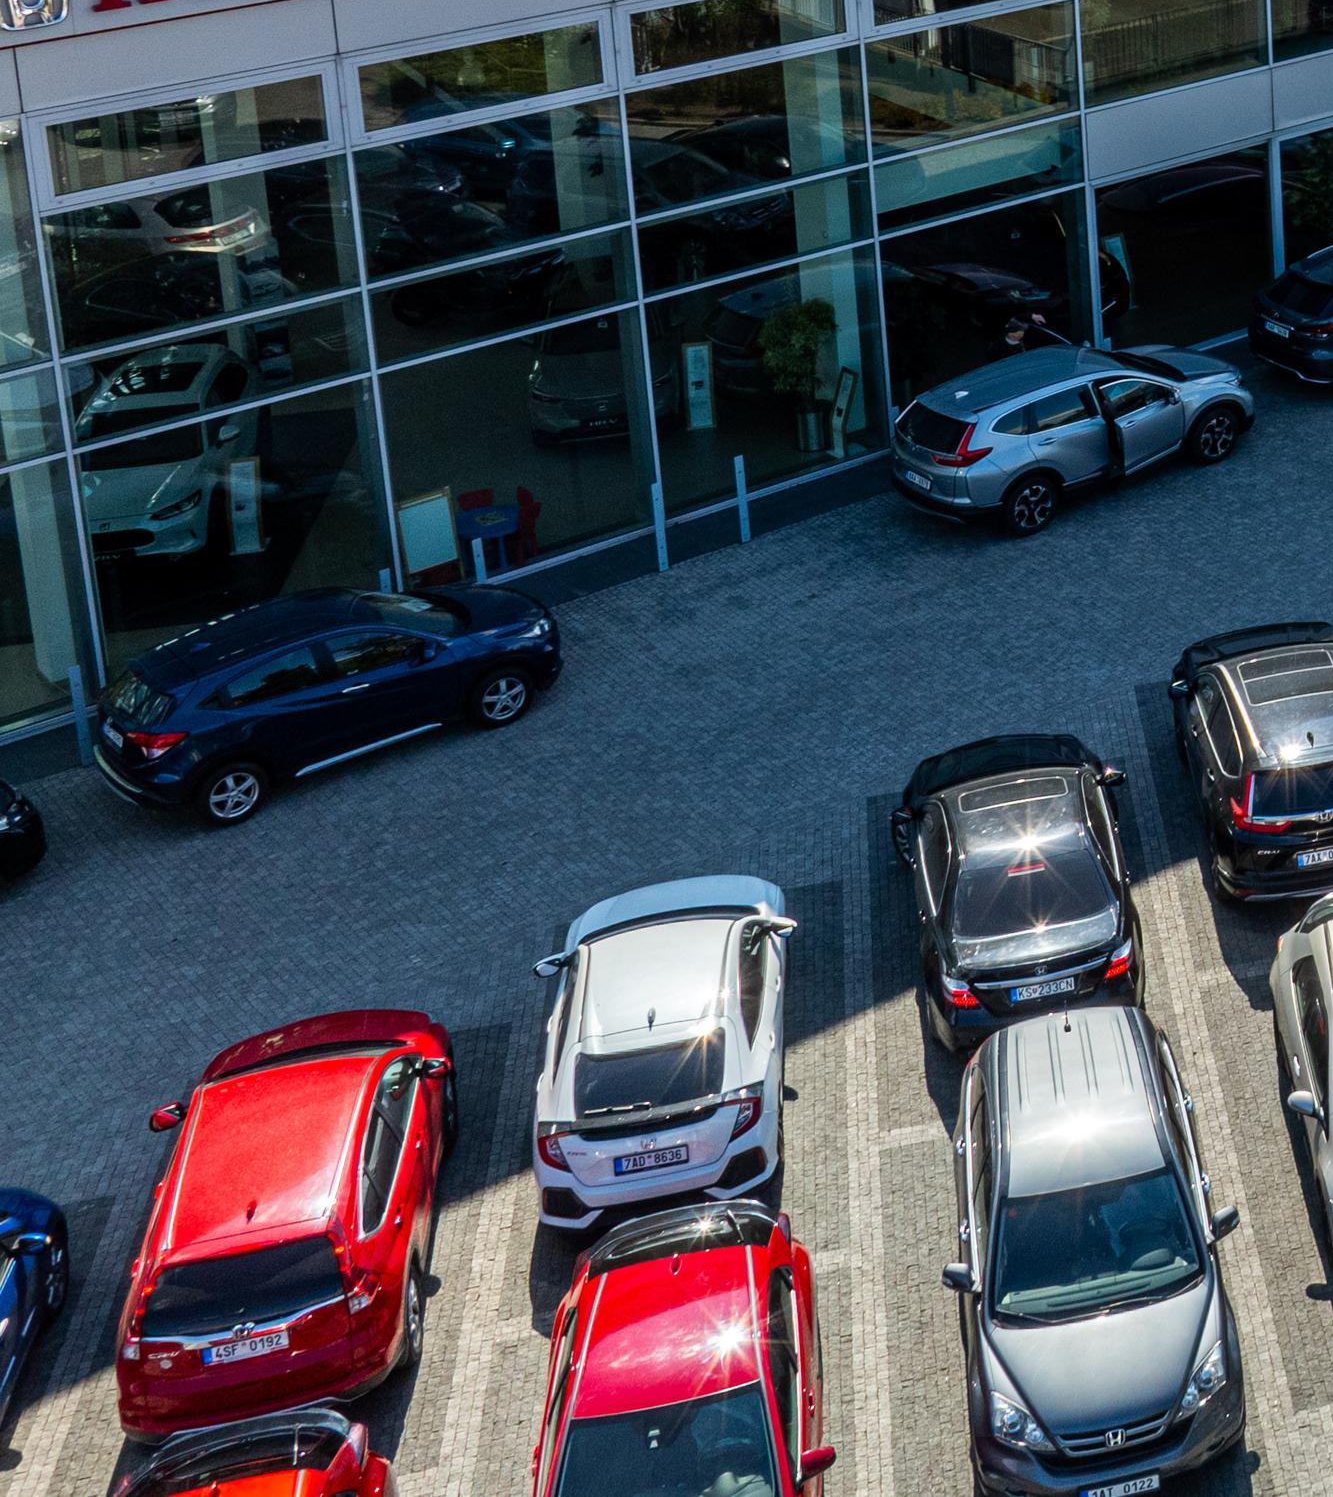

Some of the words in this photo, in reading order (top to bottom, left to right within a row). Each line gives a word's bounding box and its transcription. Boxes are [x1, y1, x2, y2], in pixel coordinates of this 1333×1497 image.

[1305, 853, 1322, 866] 7AX
[1018, 987, 1033, 999] KS
[1038, 978, 1073, 995] 233CN
[624, 1155, 646, 1170] 7AD
[654, 1148, 683, 1164] 8636
[215, 1343, 238, 1360] 4SF
[249, 1333, 283, 1351] 0192
[1123, 1477, 1154, 1494] 0122
